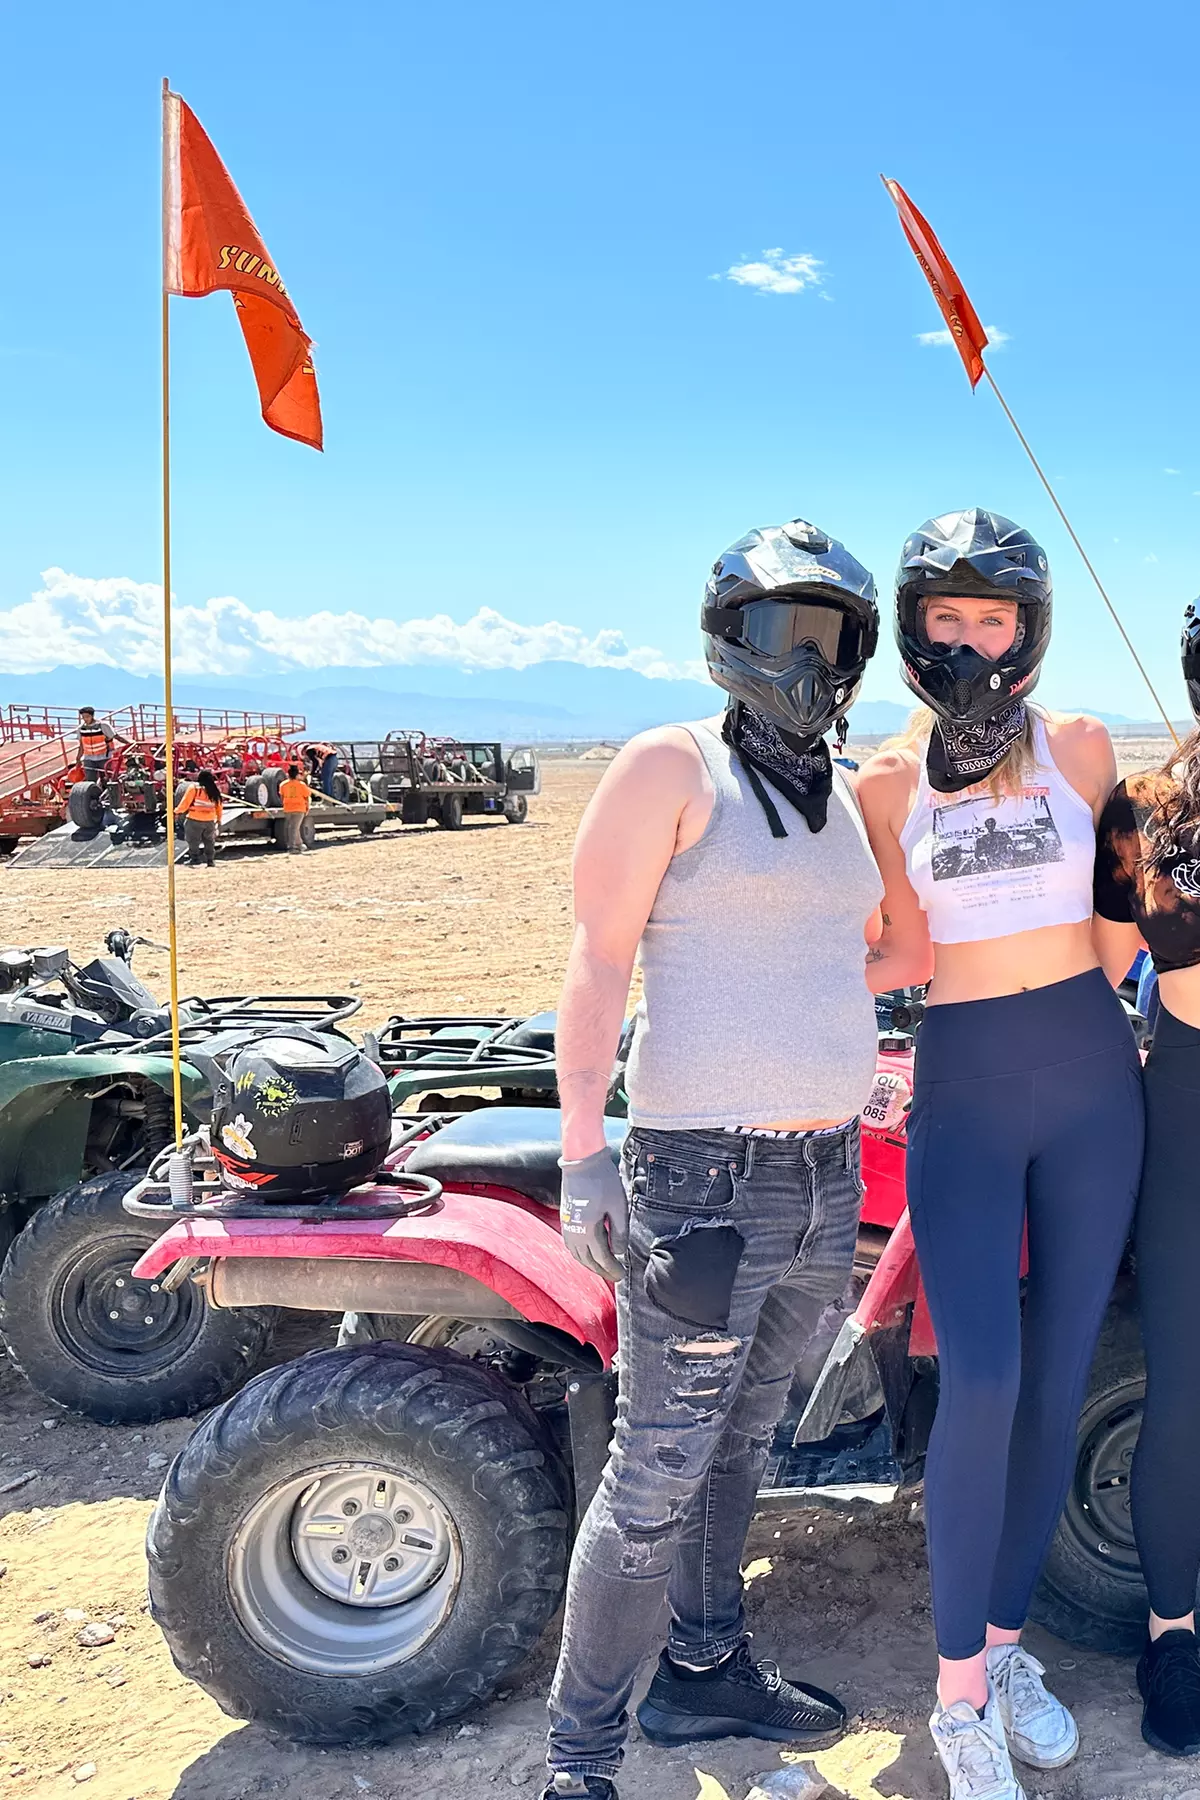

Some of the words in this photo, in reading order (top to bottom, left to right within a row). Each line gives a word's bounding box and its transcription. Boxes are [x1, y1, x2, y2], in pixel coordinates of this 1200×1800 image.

[26, 1012, 67, 1028] YAMAHA
[878, 1075, 899, 1090] QU
[863, 1105, 888, 1121] 085
